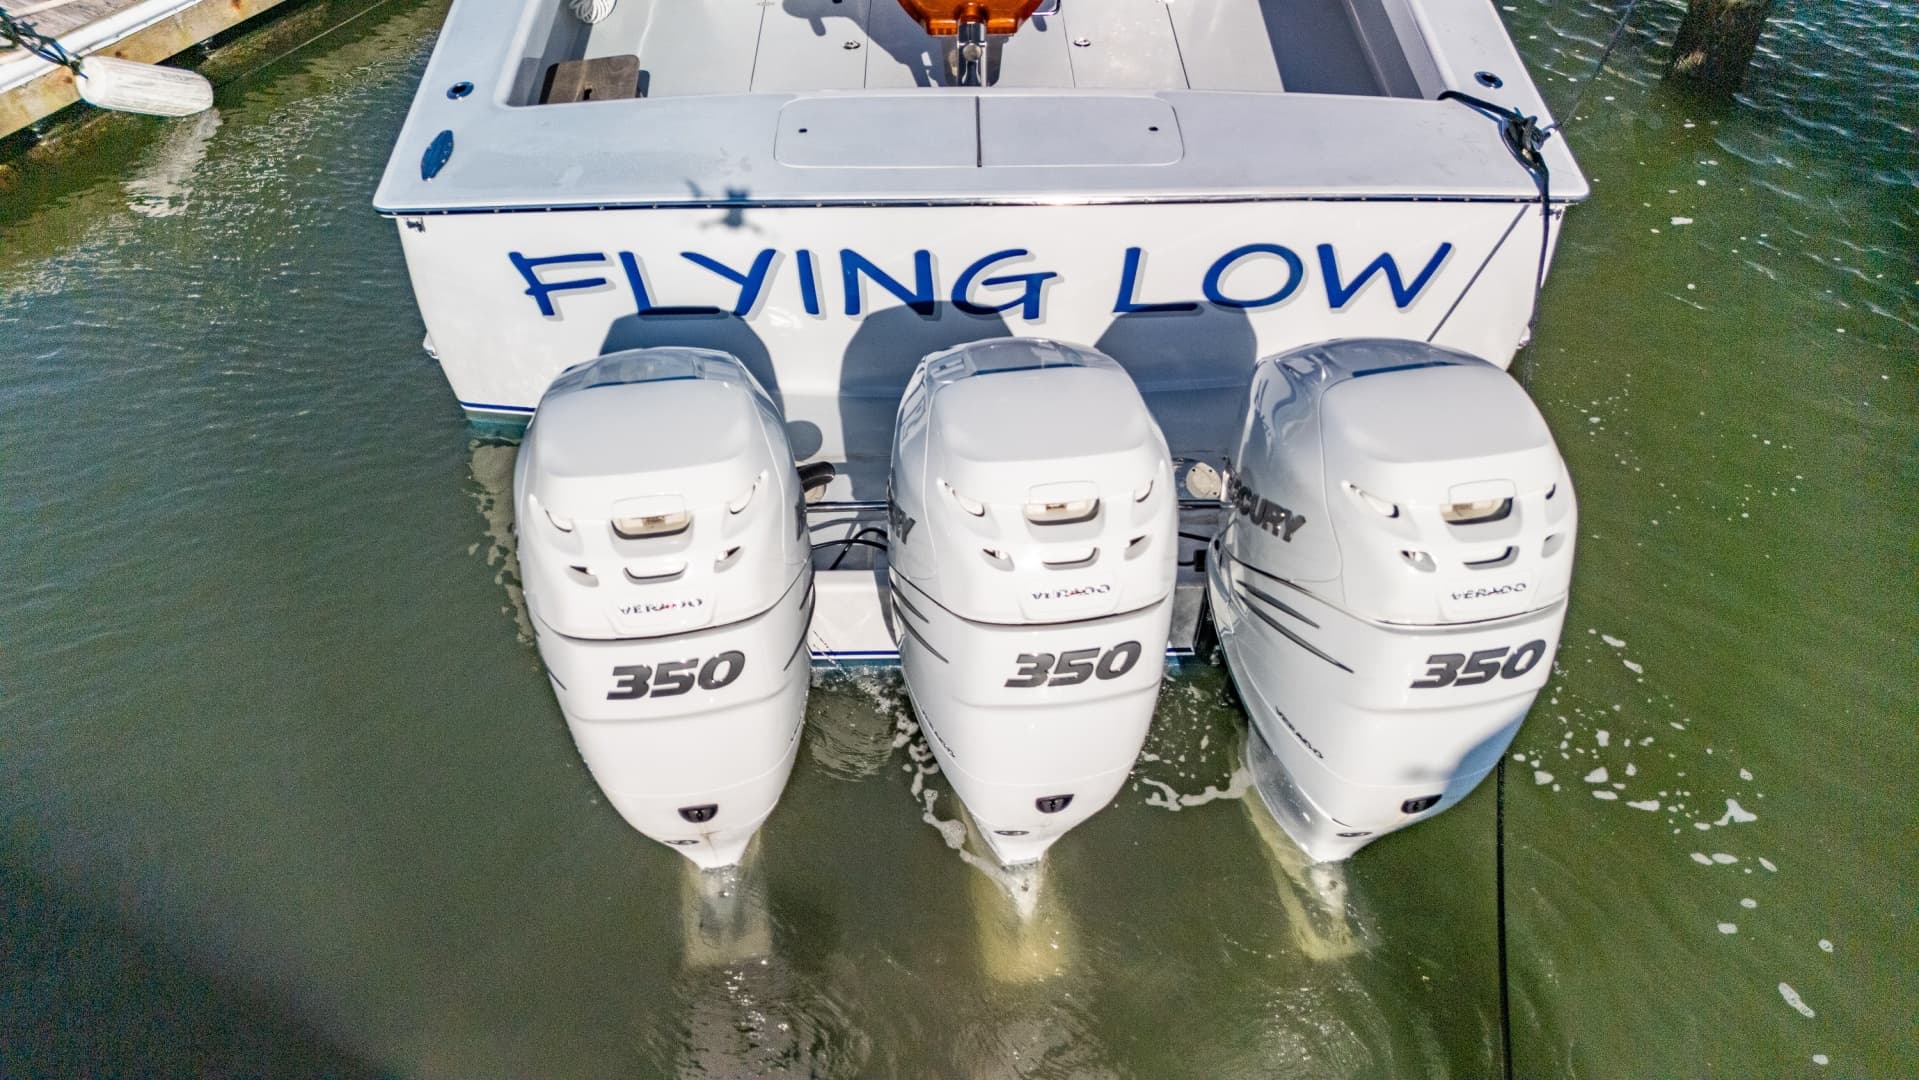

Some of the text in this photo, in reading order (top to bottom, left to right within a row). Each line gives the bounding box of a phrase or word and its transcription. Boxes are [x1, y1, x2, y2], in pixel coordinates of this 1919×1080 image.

[509, 242, 1453, 320] FLYING LOW
[607, 650, 746, 700] 350
[1005, 640, 1142, 688] 350
[1411, 639, 1546, 689] 350
